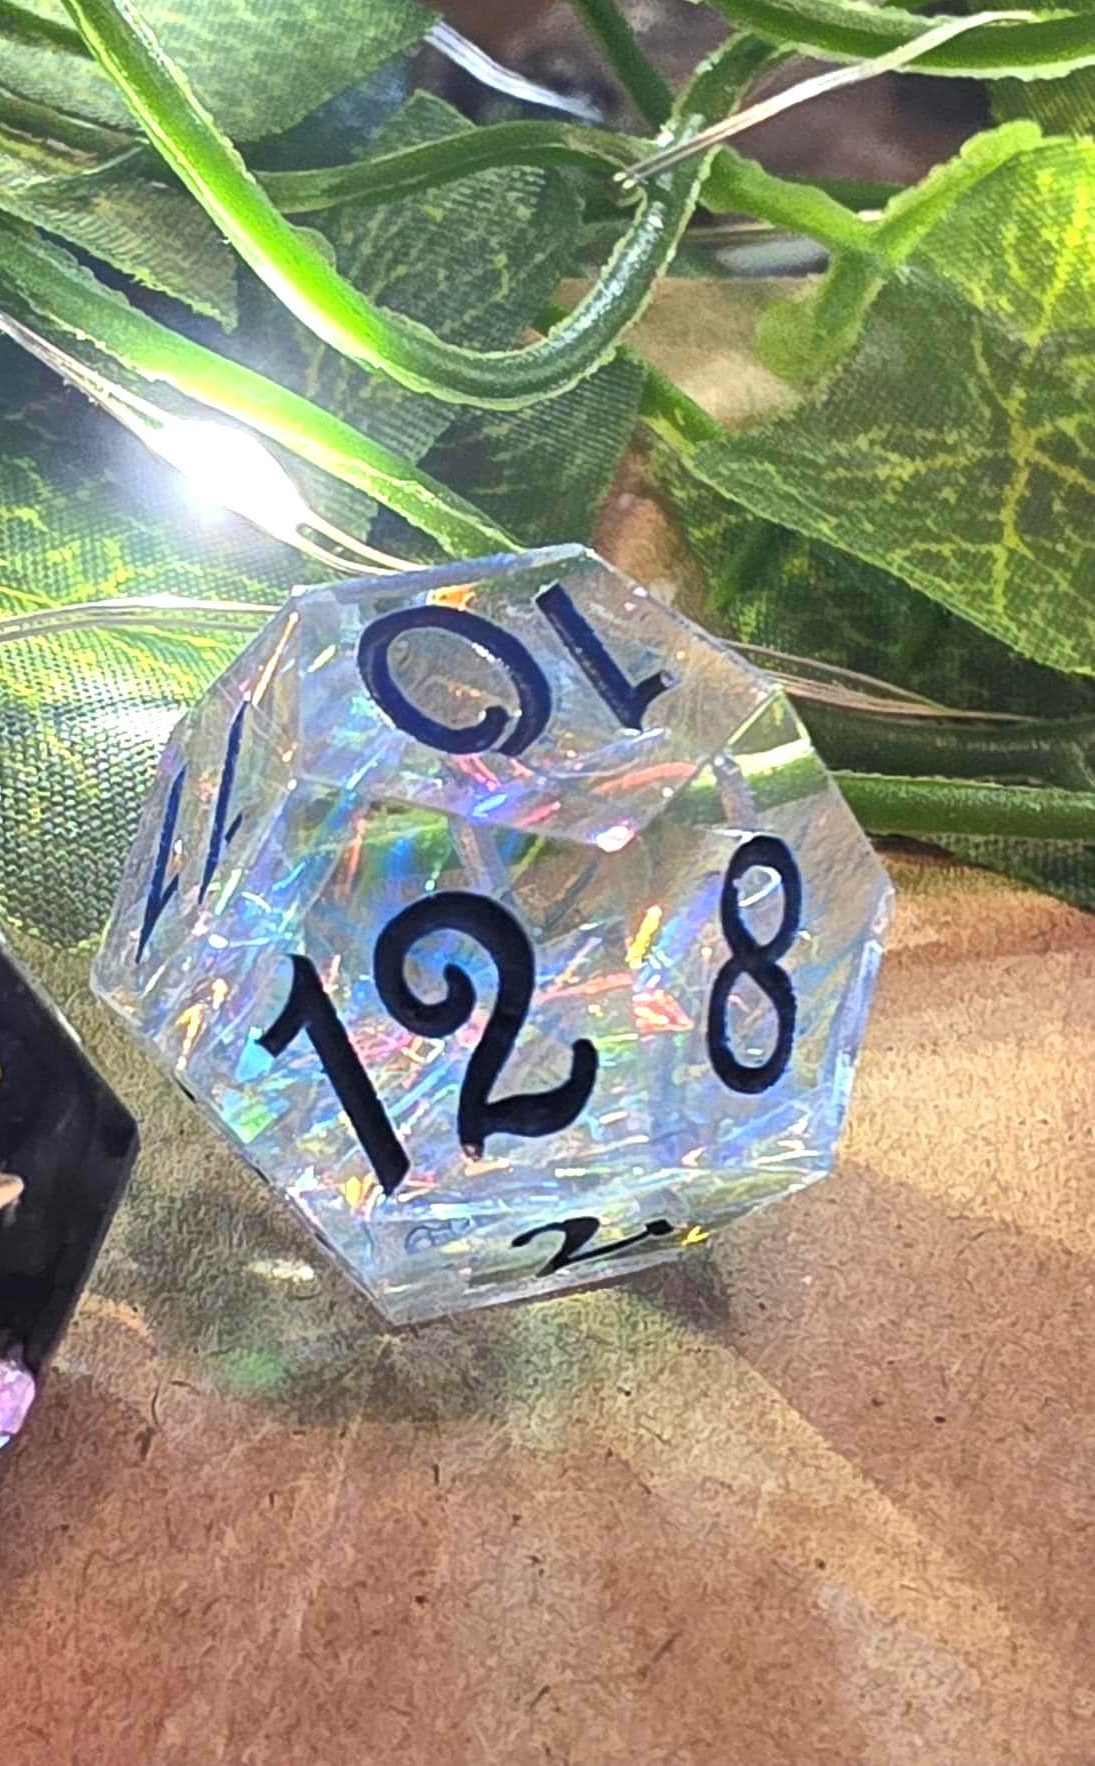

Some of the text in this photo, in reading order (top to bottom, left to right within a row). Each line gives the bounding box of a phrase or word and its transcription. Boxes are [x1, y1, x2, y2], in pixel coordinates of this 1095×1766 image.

[357, 583, 675, 758] 10
[256, 891, 598, 1197] 12
[708, 834, 802, 1094] 8
